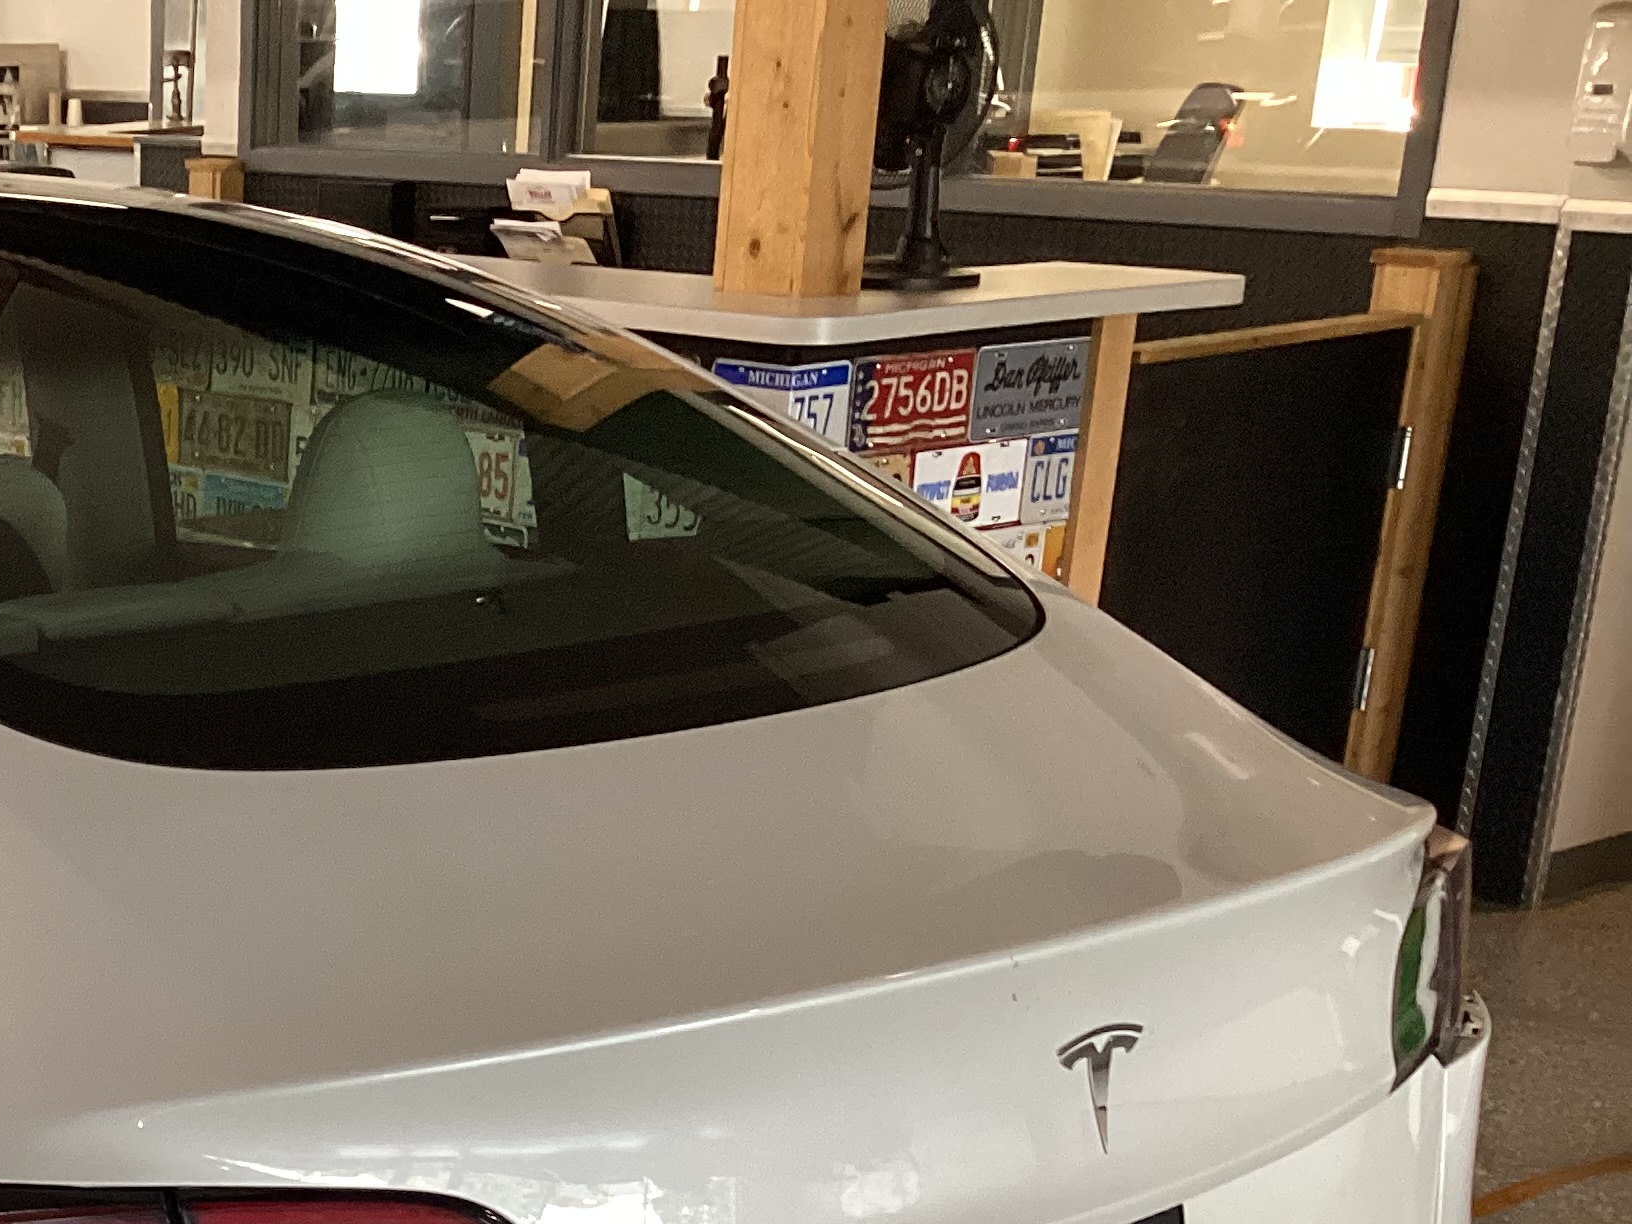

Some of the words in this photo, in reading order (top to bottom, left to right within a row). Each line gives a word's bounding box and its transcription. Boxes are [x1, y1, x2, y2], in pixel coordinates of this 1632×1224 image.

[748, 369, 819, 387] MICHIGAN
[861, 368, 969, 421] 2756DB
[976, 401, 1026, 419] LINCOLN
[1029, 394, 1082, 412] MERCURY
[1030, 457, 1069, 504] CLG
